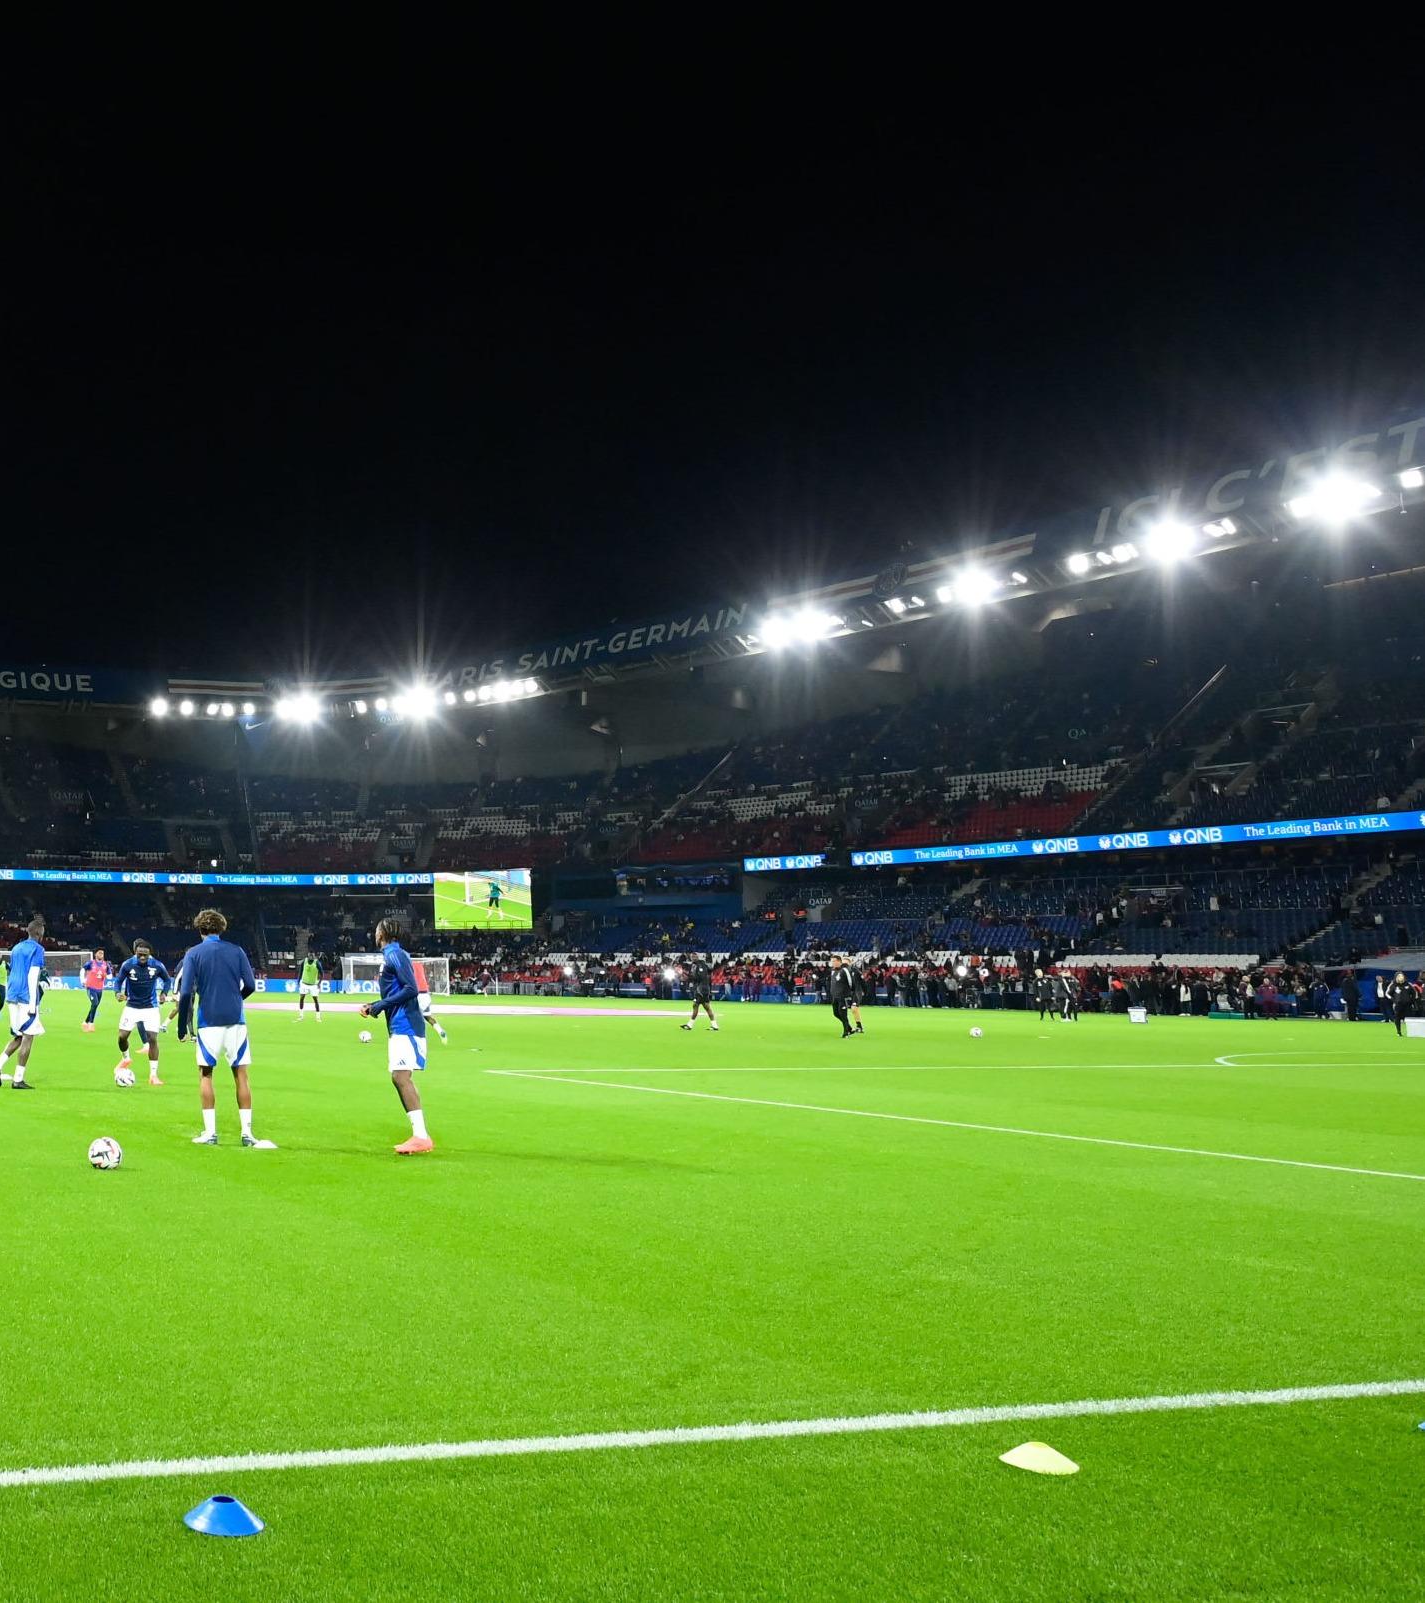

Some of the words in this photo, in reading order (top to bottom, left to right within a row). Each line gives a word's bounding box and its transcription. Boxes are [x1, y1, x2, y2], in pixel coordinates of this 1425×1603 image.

[516, 604, 748, 674] SAINT-GERMAIN
[1243, 826, 1265, 836] The
[1267, 824, 1311, 835] Leading
[1313, 821, 1343, 831] Bank
[1359, 818, 1389, 828] MEA
[1112, 833, 1149, 848] QNB
[1183, 828, 1223, 843] QNB
[915, 851, 931, 859] The
[931, 849, 963, 859] Leading
[964, 847, 985, 855] Bank
[997, 844, 1019, 853] MEA
[1045, 839, 1079, 853] QNB
[755, 858, 781, 870] QNB
[865, 852, 893, 864] QNB
[131, 873, 155, 882] QNB
[178, 874, 203, 883] QNB
[323, 875, 349, 884] QNB
[366, 874, 392, 884] QNB
[405, 874, 431, 883] QNB
[808, 898, 832, 906] QATAR
[384, 908, 407, 916] QATAR
